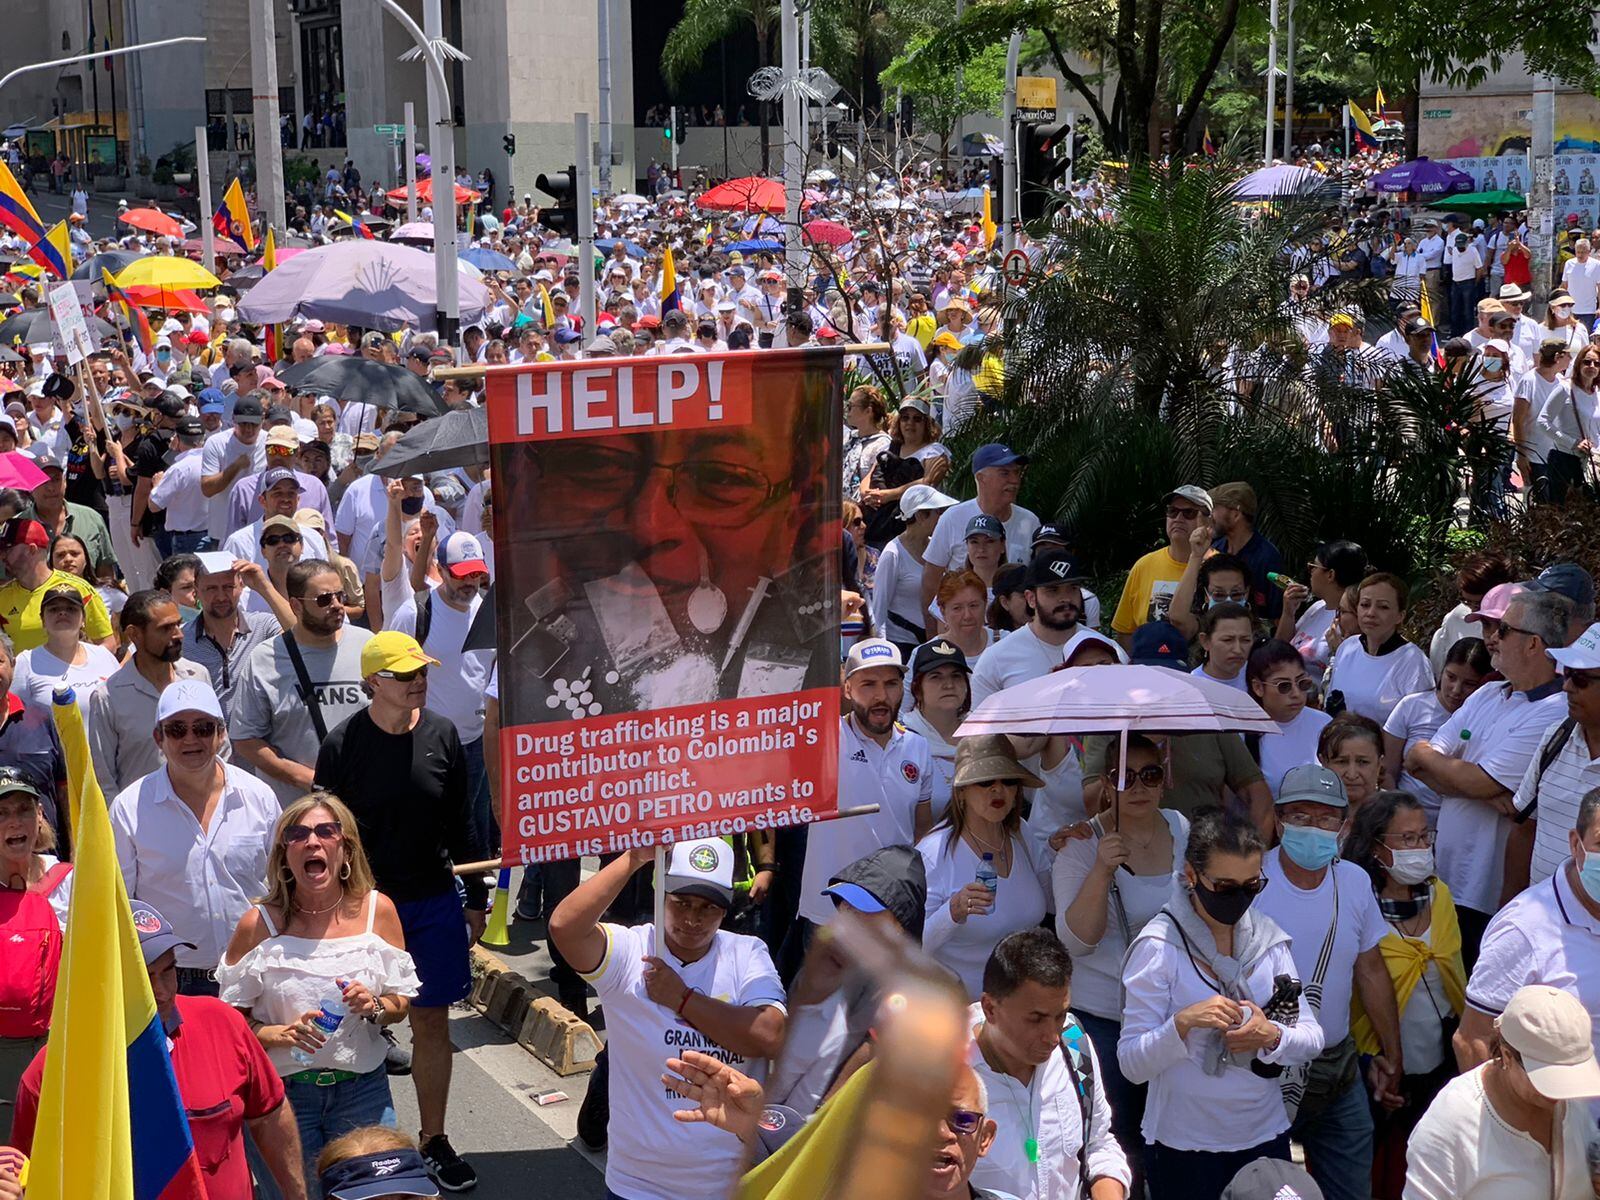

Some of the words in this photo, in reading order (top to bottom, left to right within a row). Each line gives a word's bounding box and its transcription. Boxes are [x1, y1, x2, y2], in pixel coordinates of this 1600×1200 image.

[517, 361, 725, 435] HELP!
[516, 731, 575, 756] Drug
[580, 714, 705, 748] trafficking
[710, 710, 730, 731] is
[736, 710, 749, 728] a
[756, 700, 822, 726] major
[516, 749, 652, 784] contributor
[657, 743, 681, 764] to
[687, 725, 818, 760] Colombia's
[517, 780, 594, 811] armed
[600, 768, 697, 799] conflict.
[518, 802, 631, 838] GUSTAVO
[638, 790, 713, 821] PETRO
[718, 782, 786, 808] wants
[791, 779, 814, 798] to
[519, 842, 569, 864] turn
[576, 837, 603, 856] us
[609, 828, 655, 851] into
[661, 827, 675, 844] a
[681, 804, 821, 841] narco-state.
[664, 1028, 701, 1047] GRAN
[371, 1157, 401, 1168] Reebok
